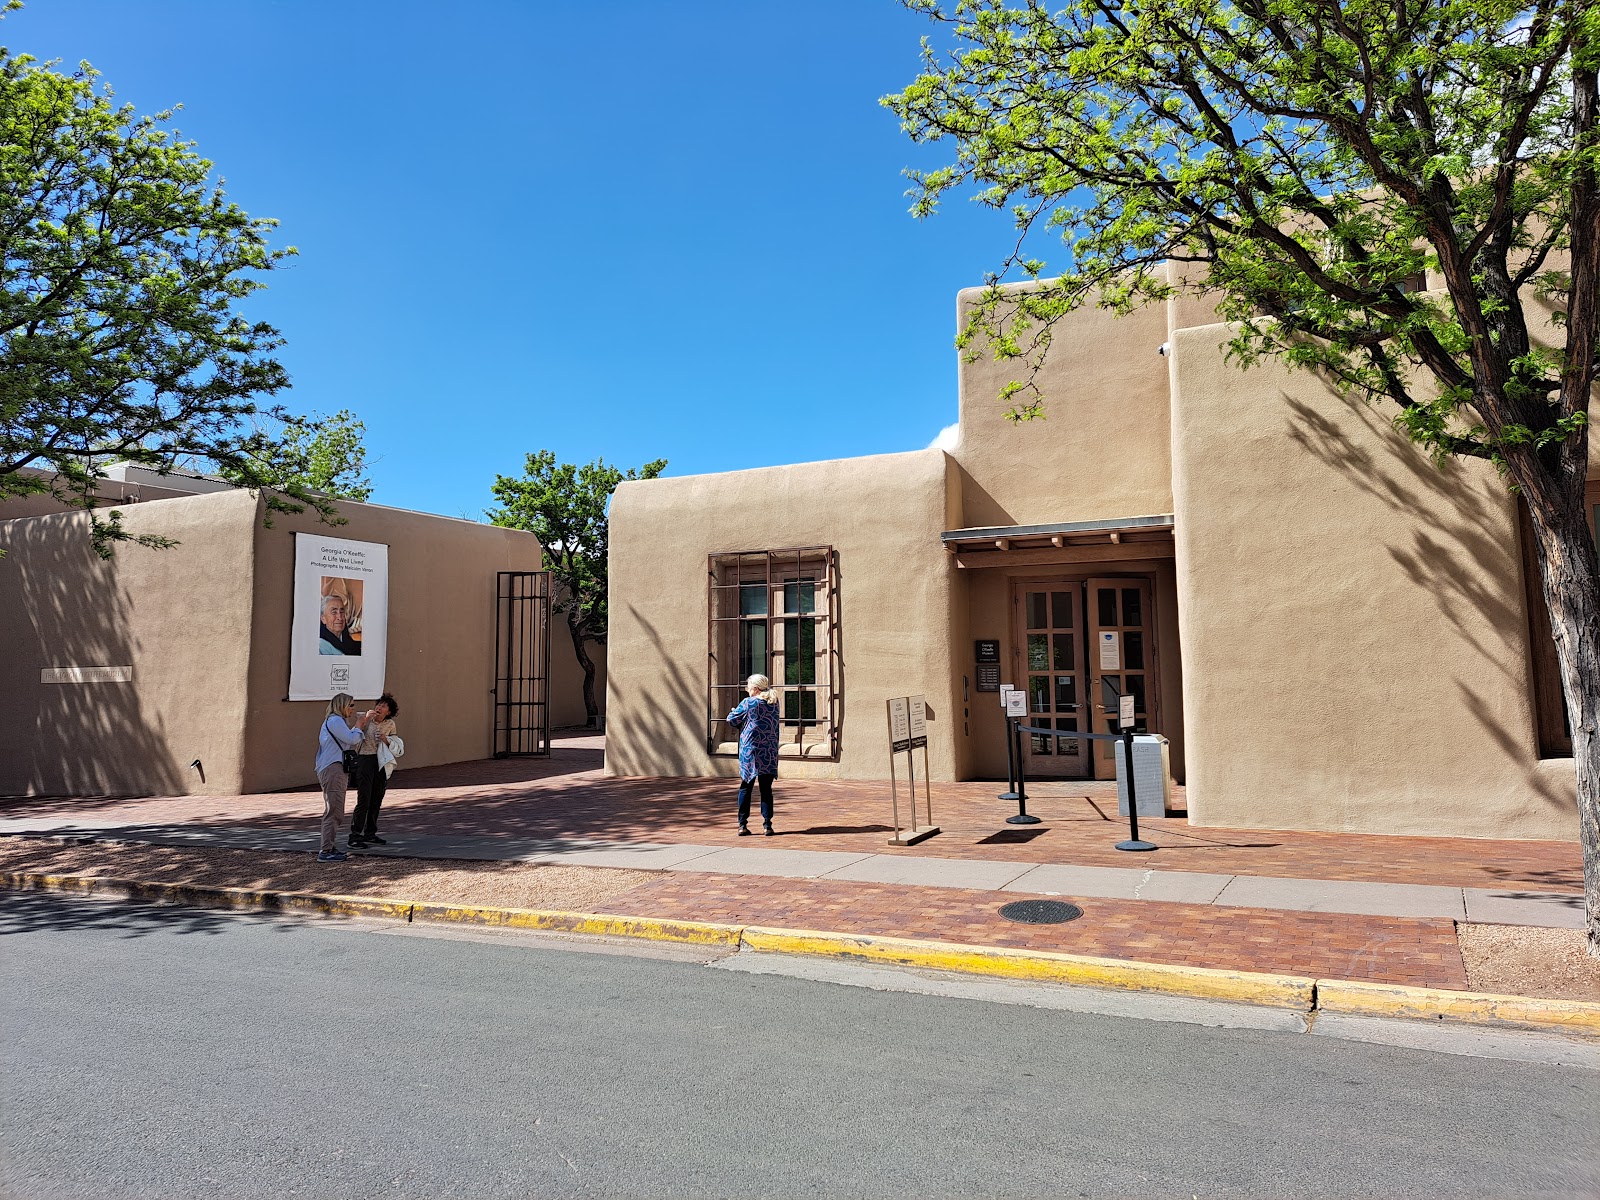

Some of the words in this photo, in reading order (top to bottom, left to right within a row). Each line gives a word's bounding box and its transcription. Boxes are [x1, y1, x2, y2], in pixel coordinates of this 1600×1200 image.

[320, 546, 342, 556] Georgia
[342, 549, 366, 558] O'Keeffe:
[310, 561, 338, 569] Photographs
[350, 558, 364, 566] Lived
